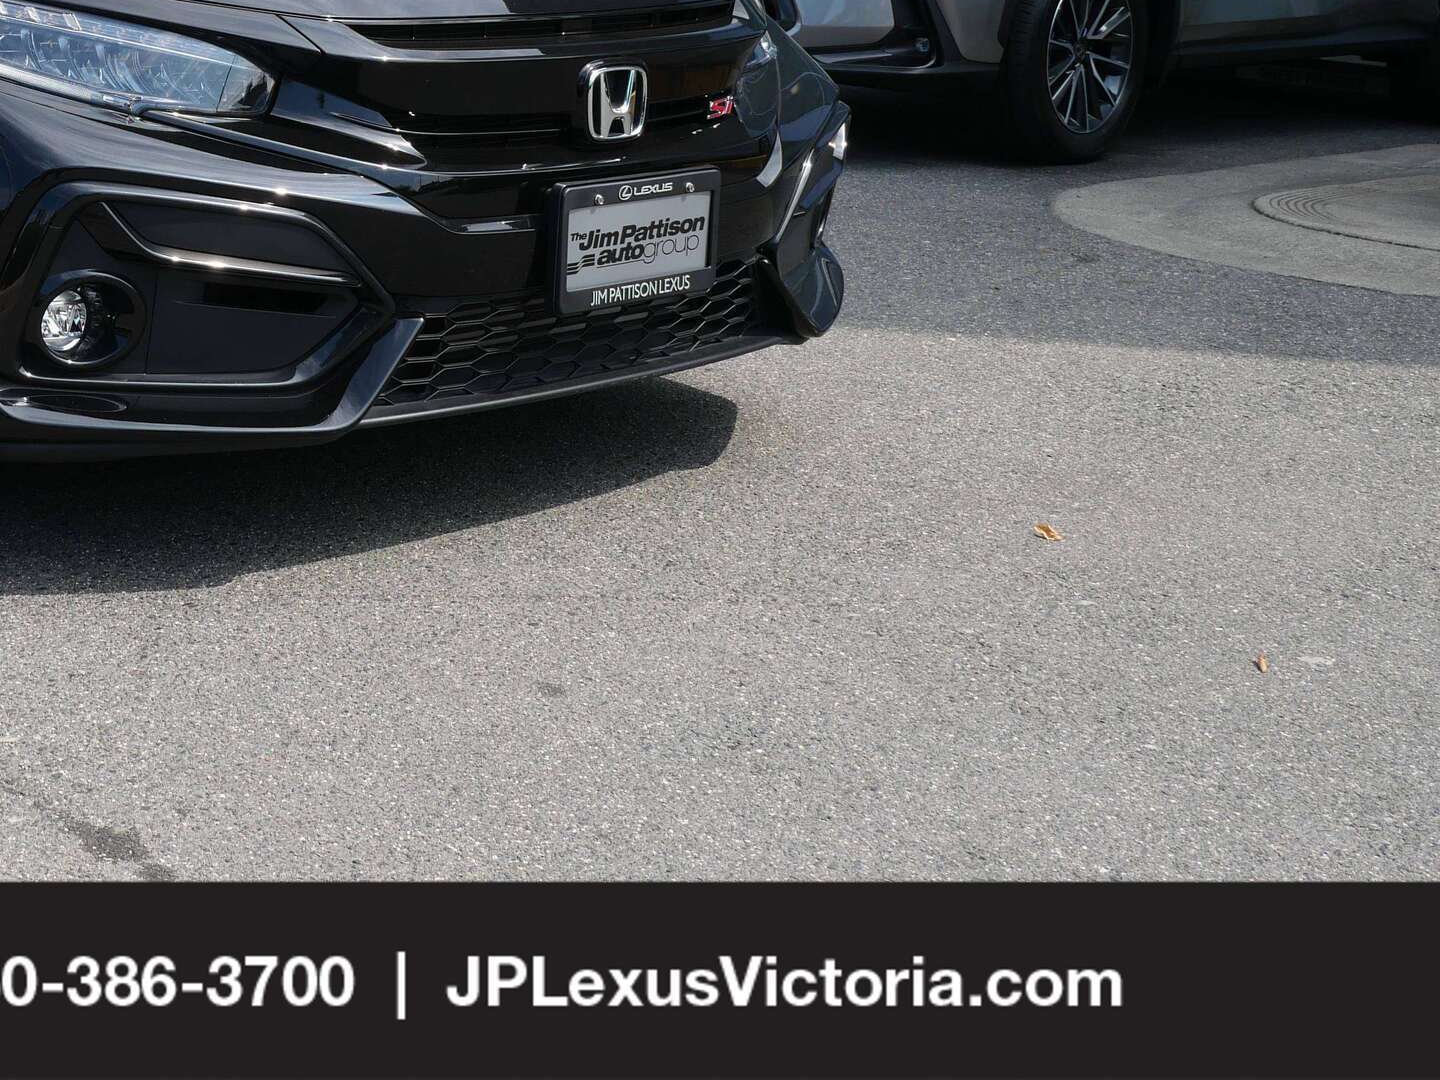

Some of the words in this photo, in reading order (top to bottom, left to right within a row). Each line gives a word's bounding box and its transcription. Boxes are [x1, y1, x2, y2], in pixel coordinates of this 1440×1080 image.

[633, 182, 673, 196] LEXUS
[570, 232, 587, 242] The
[590, 288, 608, 307] JIM
[609, 280, 658, 303] PATTISON
[659, 274, 691, 294] LEXUS
